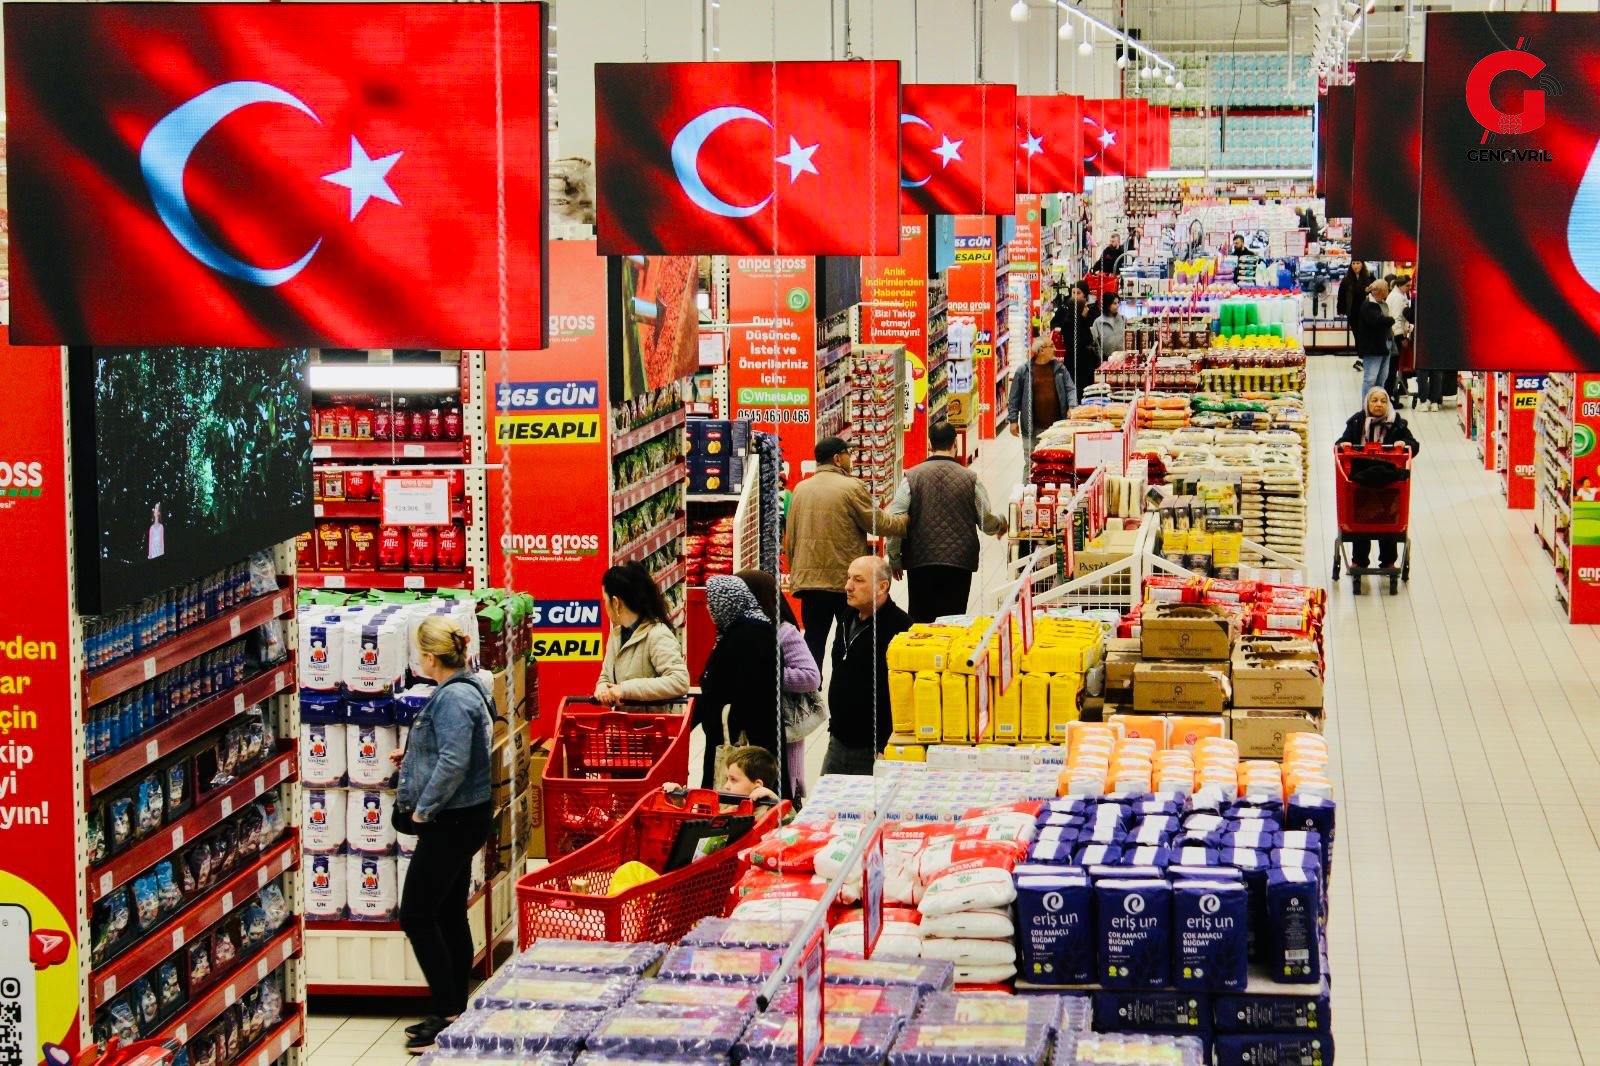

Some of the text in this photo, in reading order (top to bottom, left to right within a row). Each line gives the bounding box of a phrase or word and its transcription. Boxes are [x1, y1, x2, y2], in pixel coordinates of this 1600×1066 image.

[968, 235, 990, 246] GÜN
[738, 258, 806, 273] anpa gross
[874, 289, 916, 297] Haberdar
[752, 316, 794, 328] Duygu,
[893, 310, 916, 320] Takip
[548, 315, 595, 336] gross
[880, 320, 910, 328] etmeyi
[746, 329, 800, 343] Düşünce,
[783, 346, 797, 354] ve
[738, 356, 808, 369] Önerileriniz
[1515, 378, 1539, 389] 365
[497, 382, 596, 406] 365 GÜN
[754, 392, 807, 404] WhatsApp
[764, 409, 781, 423] 465
[783, 409, 790, 423] 0
[792, 409, 810, 423] 465
[498, 422, 597, 440] HESAPLI
[0, 462, 42, 487] oss
[500, 534, 598, 555] anpa gross
[548, 602, 598, 624] GÜN
[533, 640, 600, 656] SAPLI
[0, 676, 30, 694] ar
[0, 704, 36, 734] çin
[1032, 912, 1078, 928] eriş un
[1111, 915, 1158, 931] eriş un
[1186, 915, 1234, 931] eriş un
[1108, 938, 1134, 946] BUĞDAY
[1183, 938, 1210, 947] BUĞDAY
[1197, 932, 1223, 940] AMAÇLI
[1183, 946, 1197, 954] UNU
